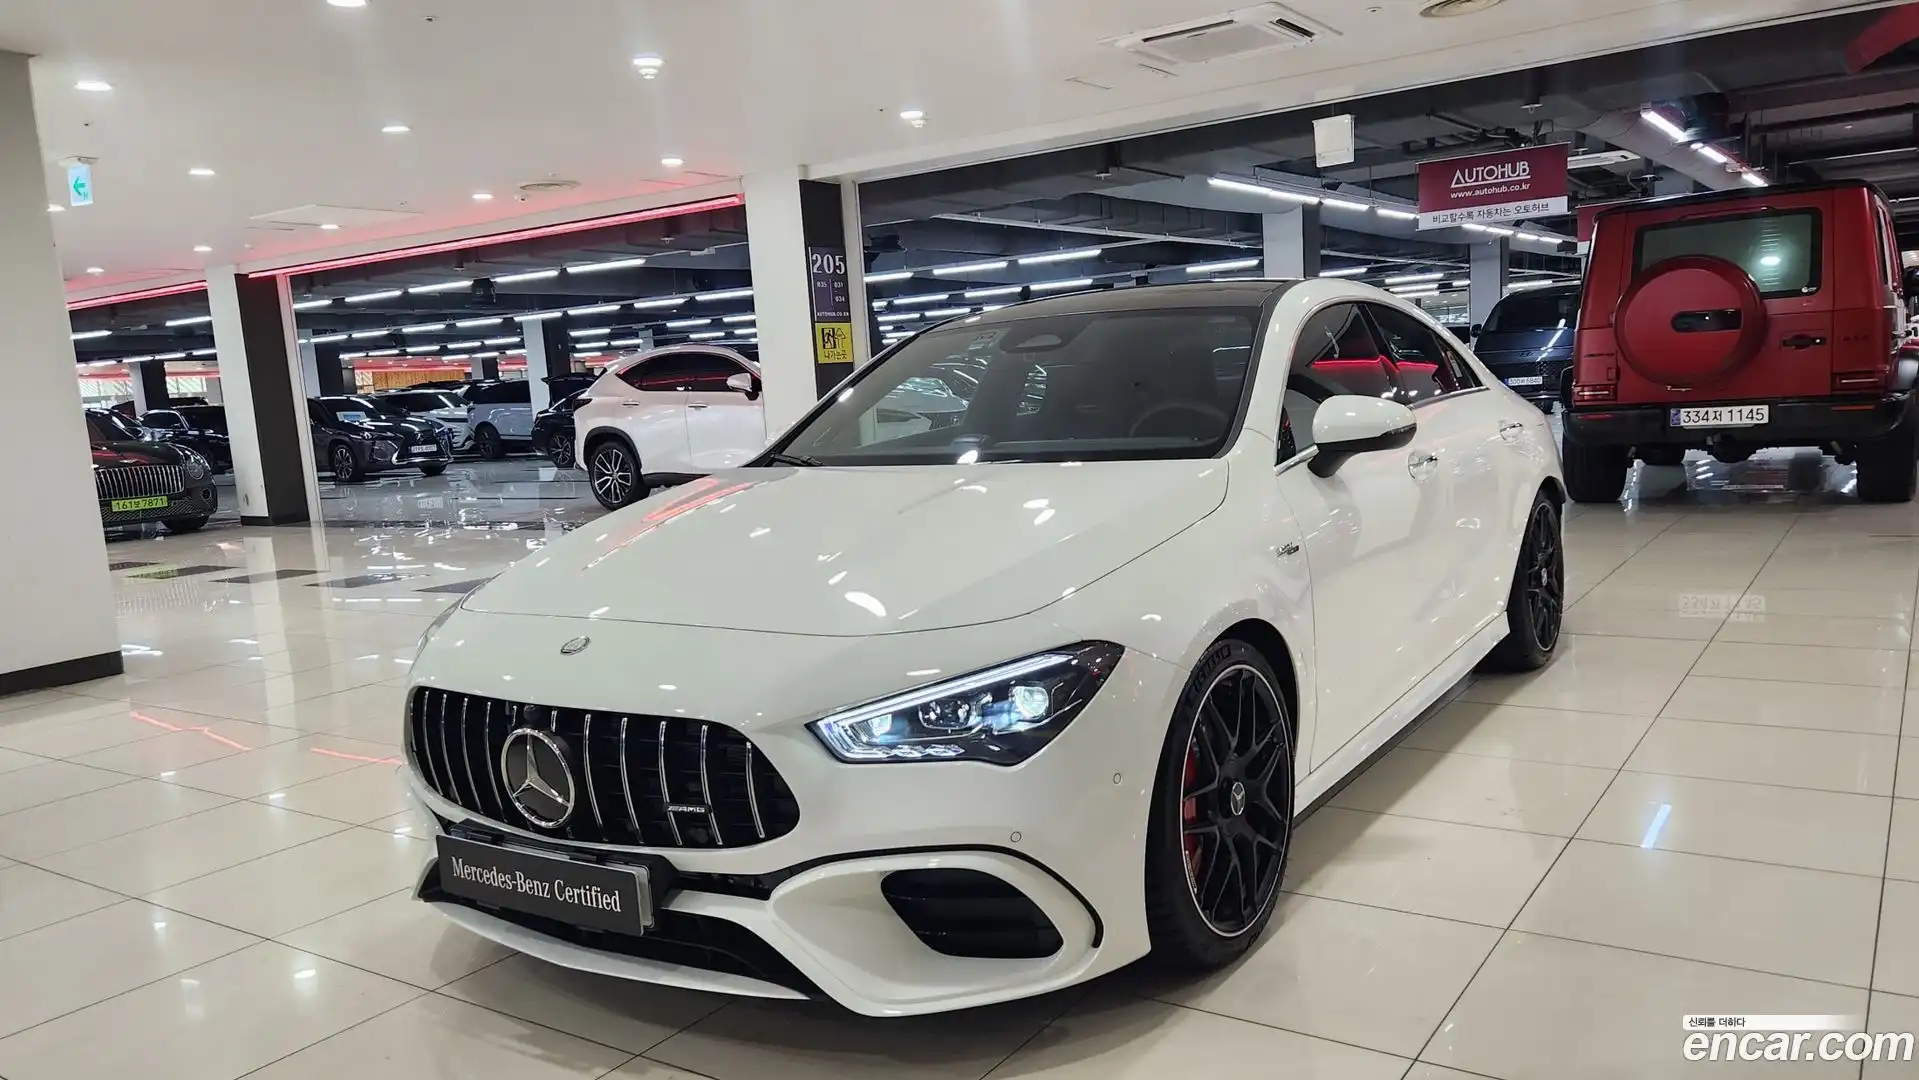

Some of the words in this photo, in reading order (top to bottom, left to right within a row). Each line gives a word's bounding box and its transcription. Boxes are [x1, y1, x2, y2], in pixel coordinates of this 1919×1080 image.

[1450, 161, 1531, 188] AUTOHUB
[1450, 182, 1530, 199] www.autohub.co.kr
[1477, 207, 1512, 219] 자동차는
[1514, 202, 1549, 215] 오토허브
[812, 253, 846, 275] 205
[823, 349, 848, 360] 나가는곳
[450, 856, 551, 899] Mercedes-Benz
[554, 879, 621, 913] Certified
